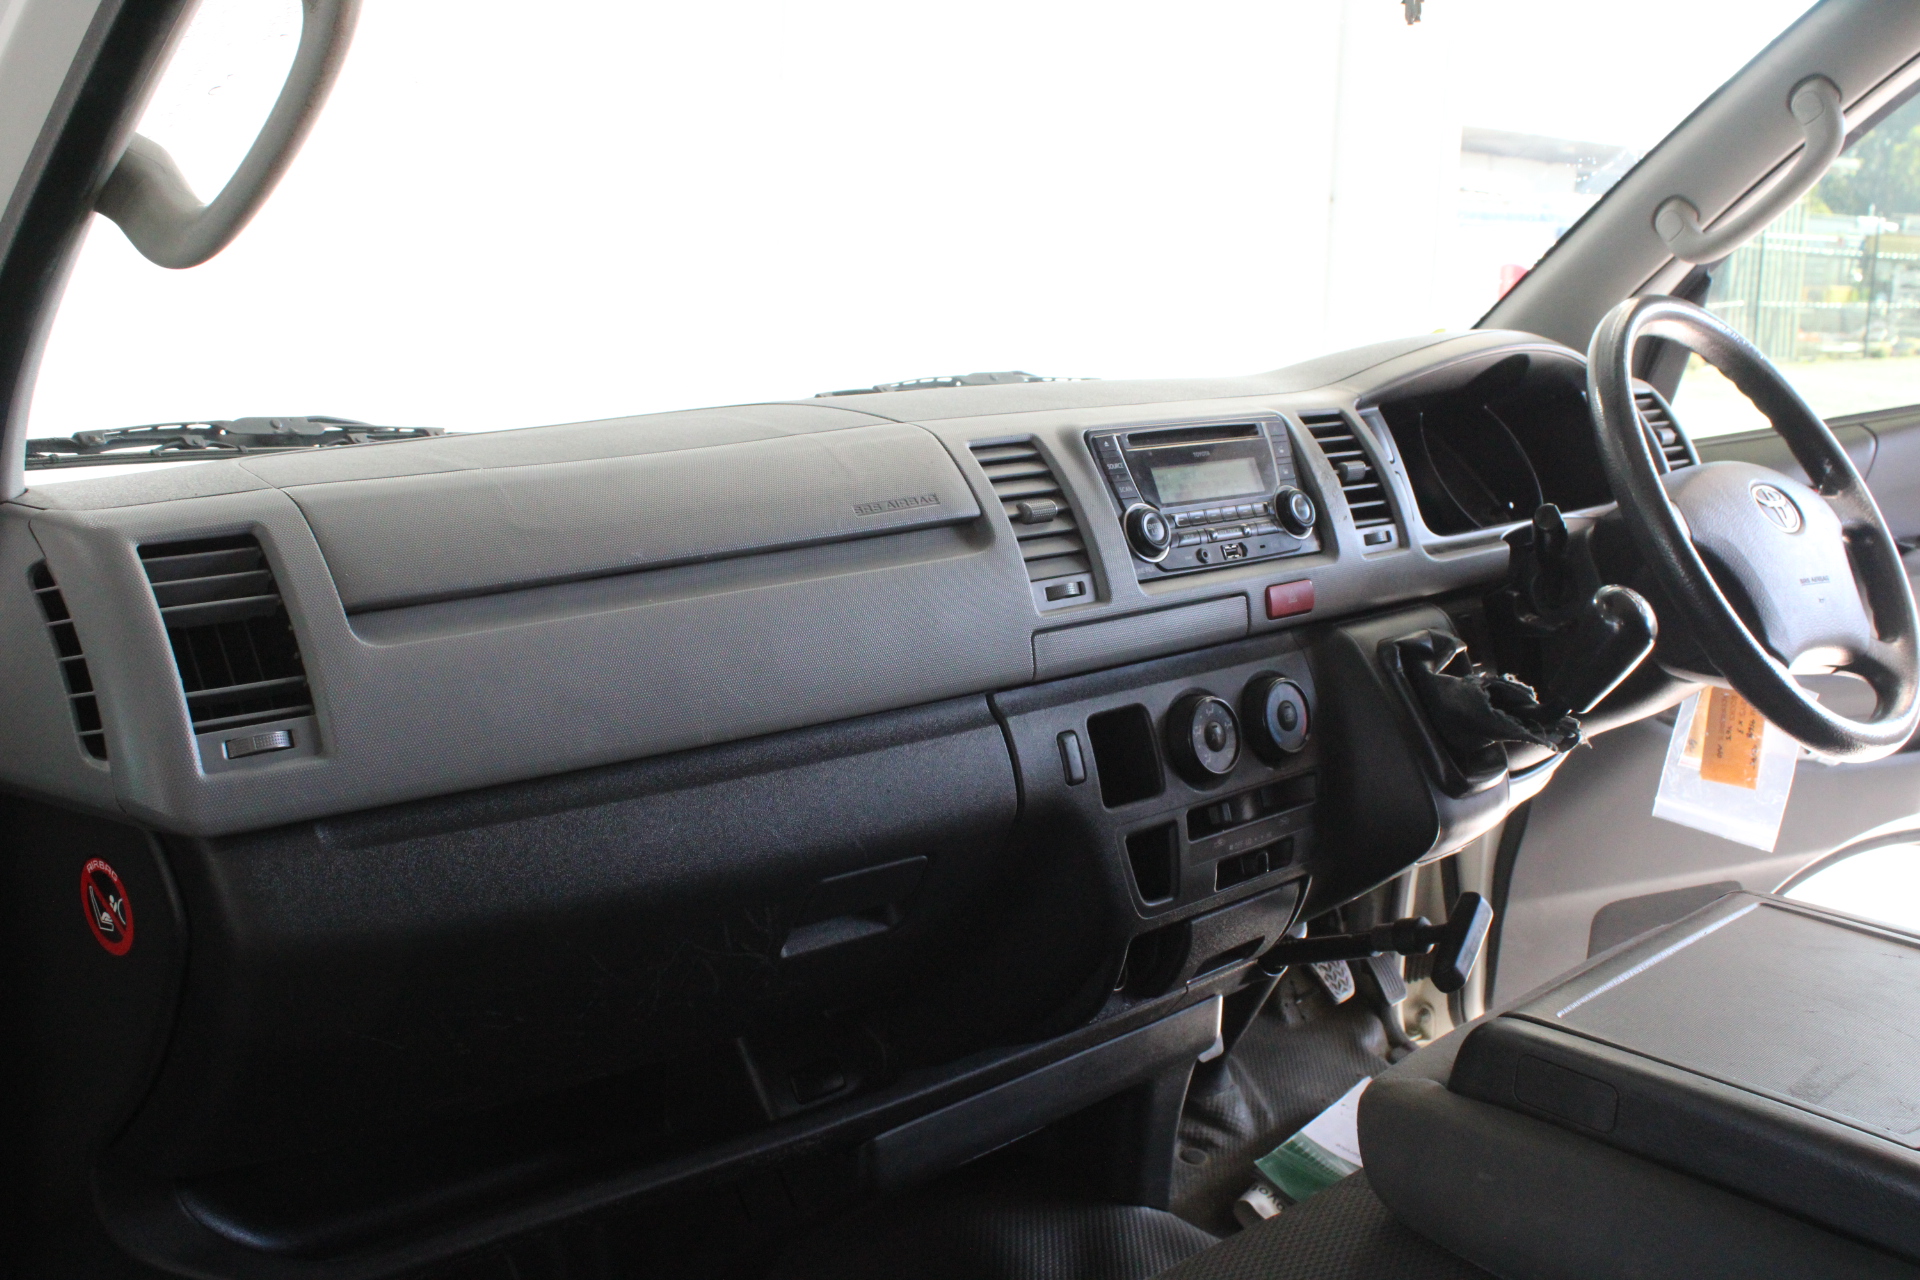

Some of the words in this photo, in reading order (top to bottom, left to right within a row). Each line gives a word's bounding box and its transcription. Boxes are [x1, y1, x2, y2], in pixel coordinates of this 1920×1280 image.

[1106, 462, 1124, 470] SOURCE
[886, 494, 939, 510] AIRBAG
[86, 860, 118, 882] AIRBAG
